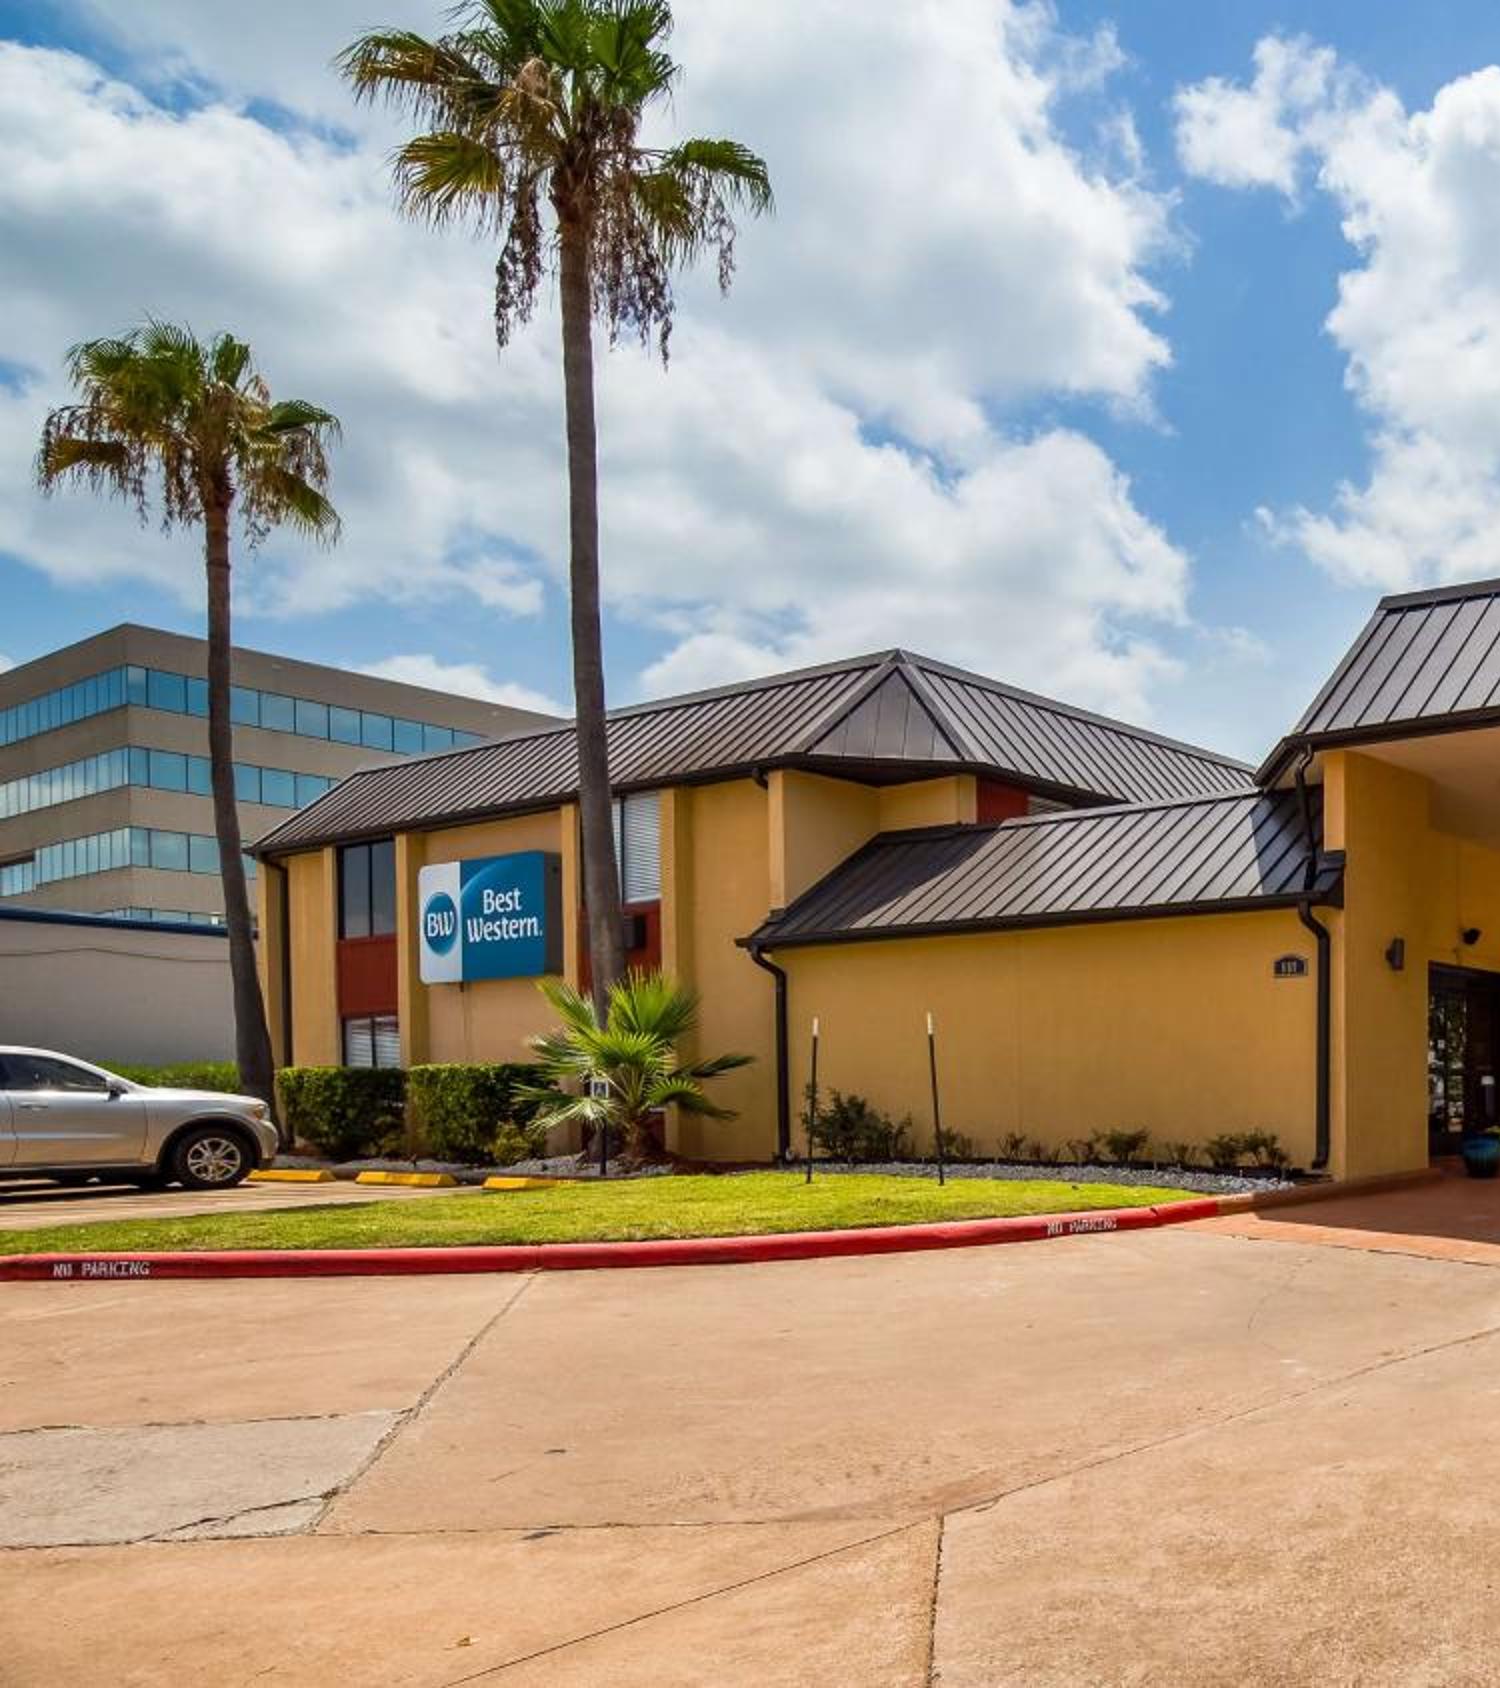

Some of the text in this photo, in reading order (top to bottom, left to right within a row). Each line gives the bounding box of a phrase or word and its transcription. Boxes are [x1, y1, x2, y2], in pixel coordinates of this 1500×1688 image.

[483, 887, 521, 914] Best
[427, 911, 454, 937] BW
[53, 1262, 150, 1277] NO PARKING
